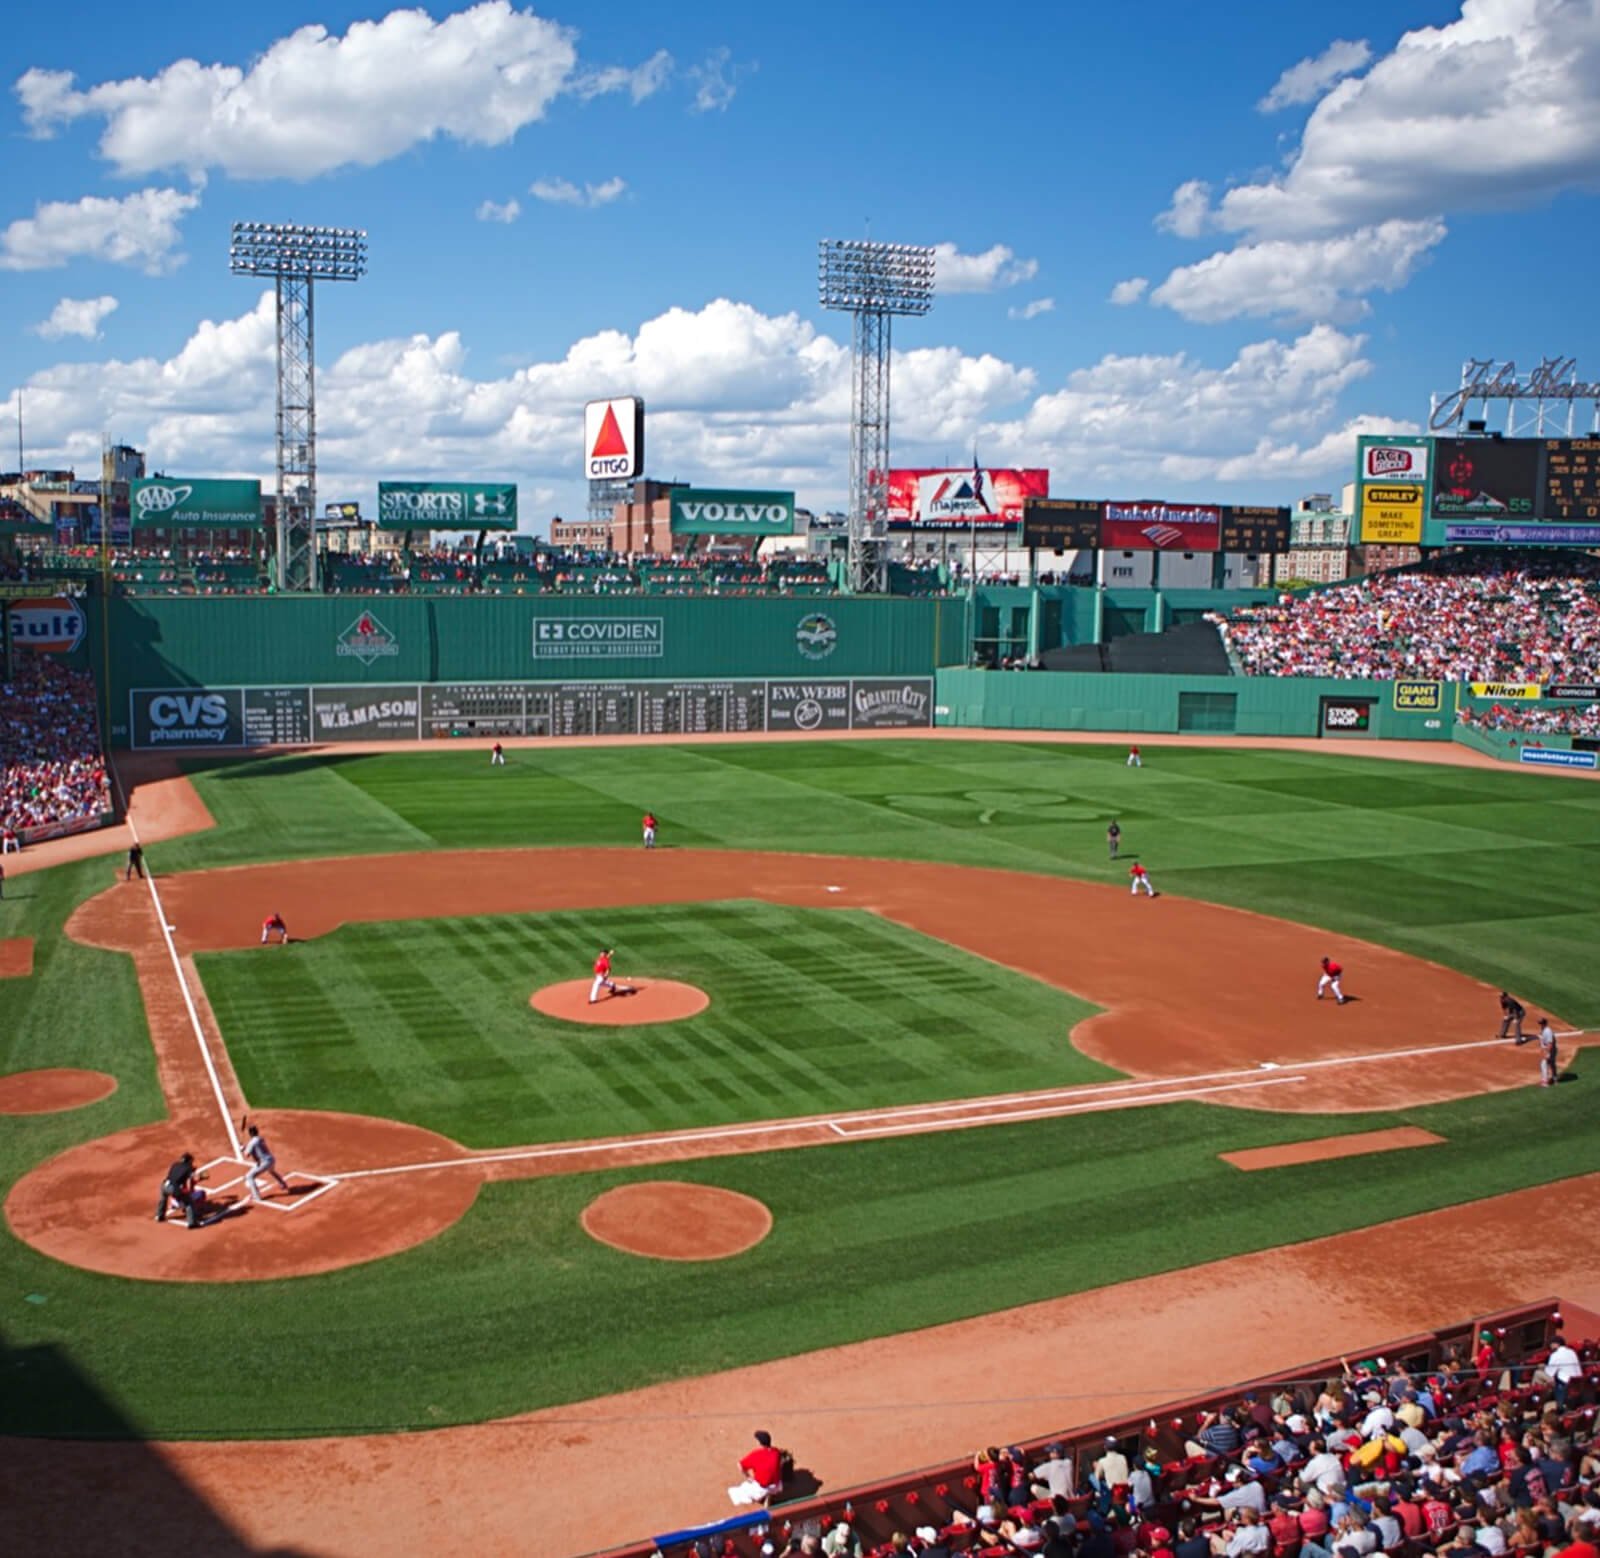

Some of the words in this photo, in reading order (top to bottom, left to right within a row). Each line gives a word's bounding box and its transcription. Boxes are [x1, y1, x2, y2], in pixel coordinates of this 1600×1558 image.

[1376, 451, 1406, 461] ACE
[591, 457, 629, 475] CITGO
[141, 486, 174, 509] AAA
[382, 492, 462, 509] SPORTS
[1371, 491, 1415, 501] STANLEY
[930, 499, 980, 514] Majestic
[1509, 498, 1532, 512] 55
[172, 511, 200, 521] Auto
[202, 511, 256, 522] Insurance
[382, 509, 462, 521] AUTHORITY
[677, 502, 788, 523] VOLVO
[1106, 504, 1142, 521] Bank
[1158, 505, 1217, 523] America
[1380, 512, 1403, 520] MAKE
[1368, 520, 1415, 530] SOMETHING
[1377, 530, 1403, 538] GREAT
[9, 614, 79, 636] Gulf
[567, 623, 657, 640] COVIDIEN
[771, 686, 800, 700] F.W.
[801, 686, 847, 700] WEBB
[1399, 685, 1436, 695] GIANT
[1484, 685, 1526, 697] Nikon
[1556, 687, 1597, 697] comcast
[855, 688, 902, 713] GRANITE
[902, 685, 928, 712] CITY
[1398, 696, 1436, 706] GLASS
[150, 694, 228, 727] CVS
[150, 727, 226, 744] pharmacy
